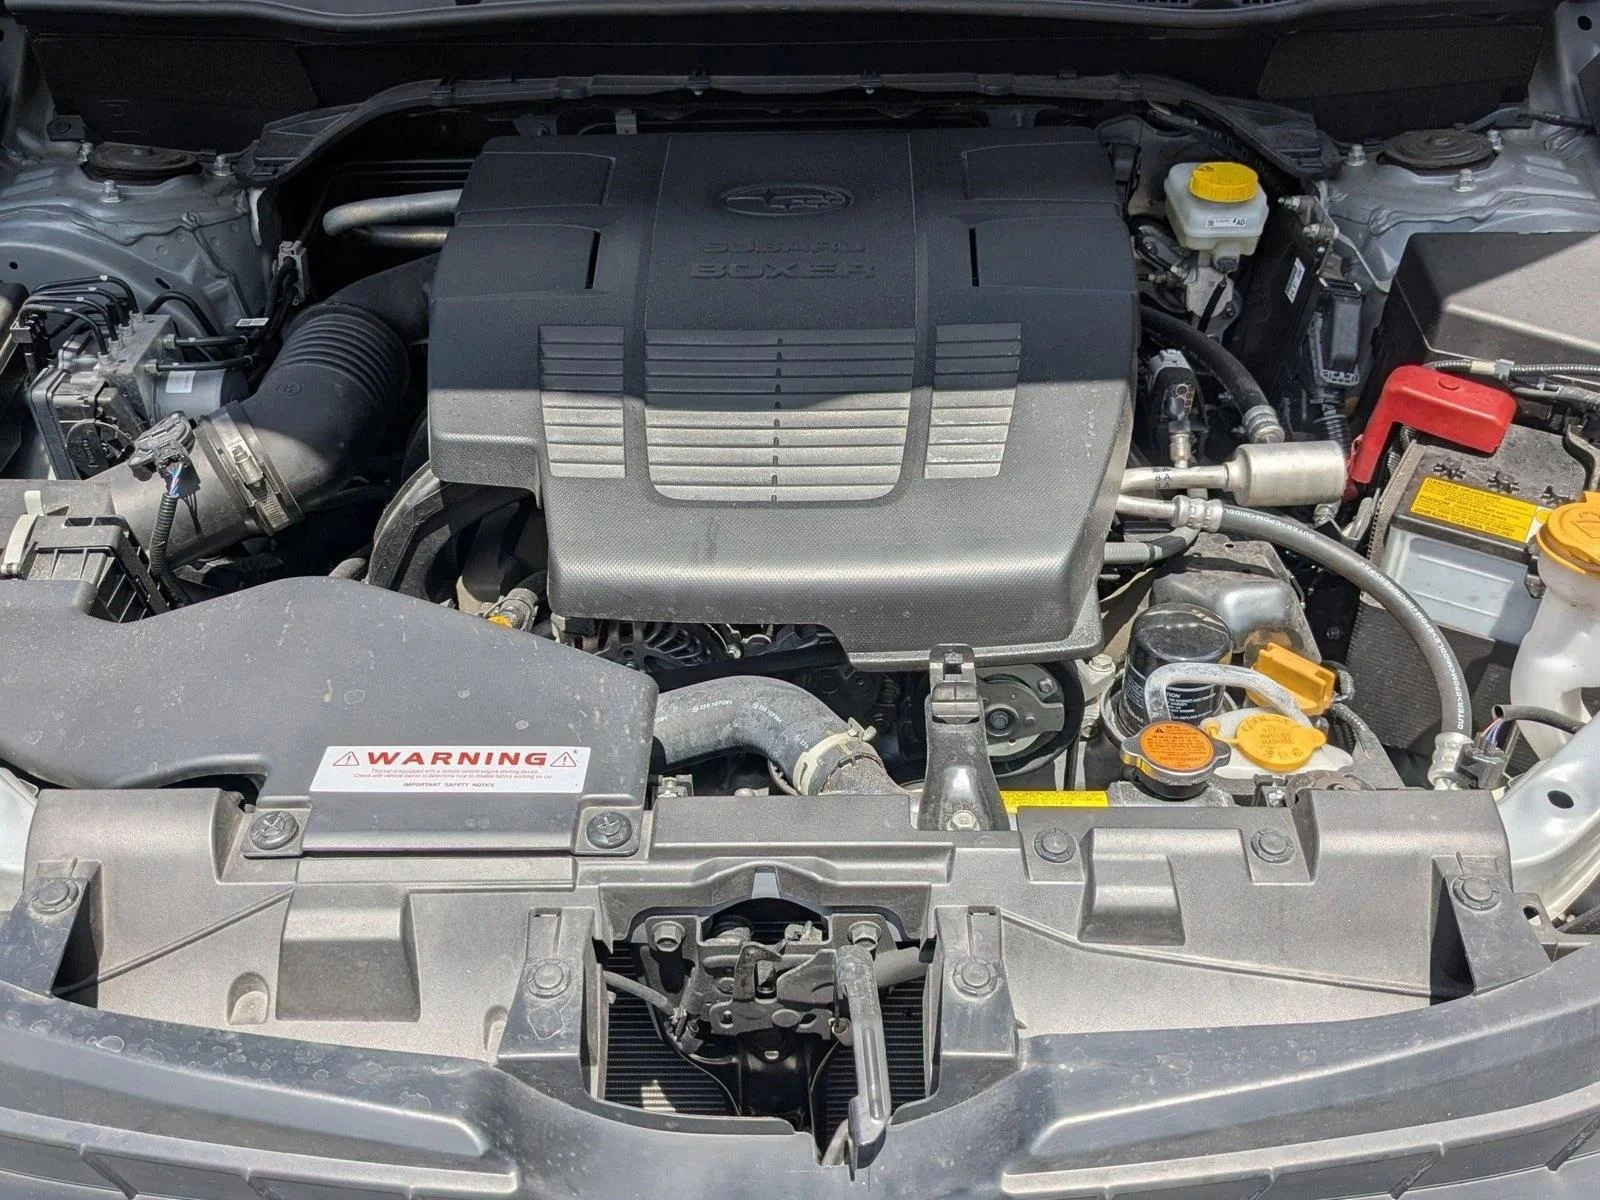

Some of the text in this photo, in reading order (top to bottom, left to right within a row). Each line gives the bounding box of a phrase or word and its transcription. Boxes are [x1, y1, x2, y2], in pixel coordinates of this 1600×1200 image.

[703, 242, 865, 254] SUBARU
[690, 263, 875, 279] BOXER
[1419, 494, 1450, 506] POISON
[367, 752, 548, 766] WARNING
